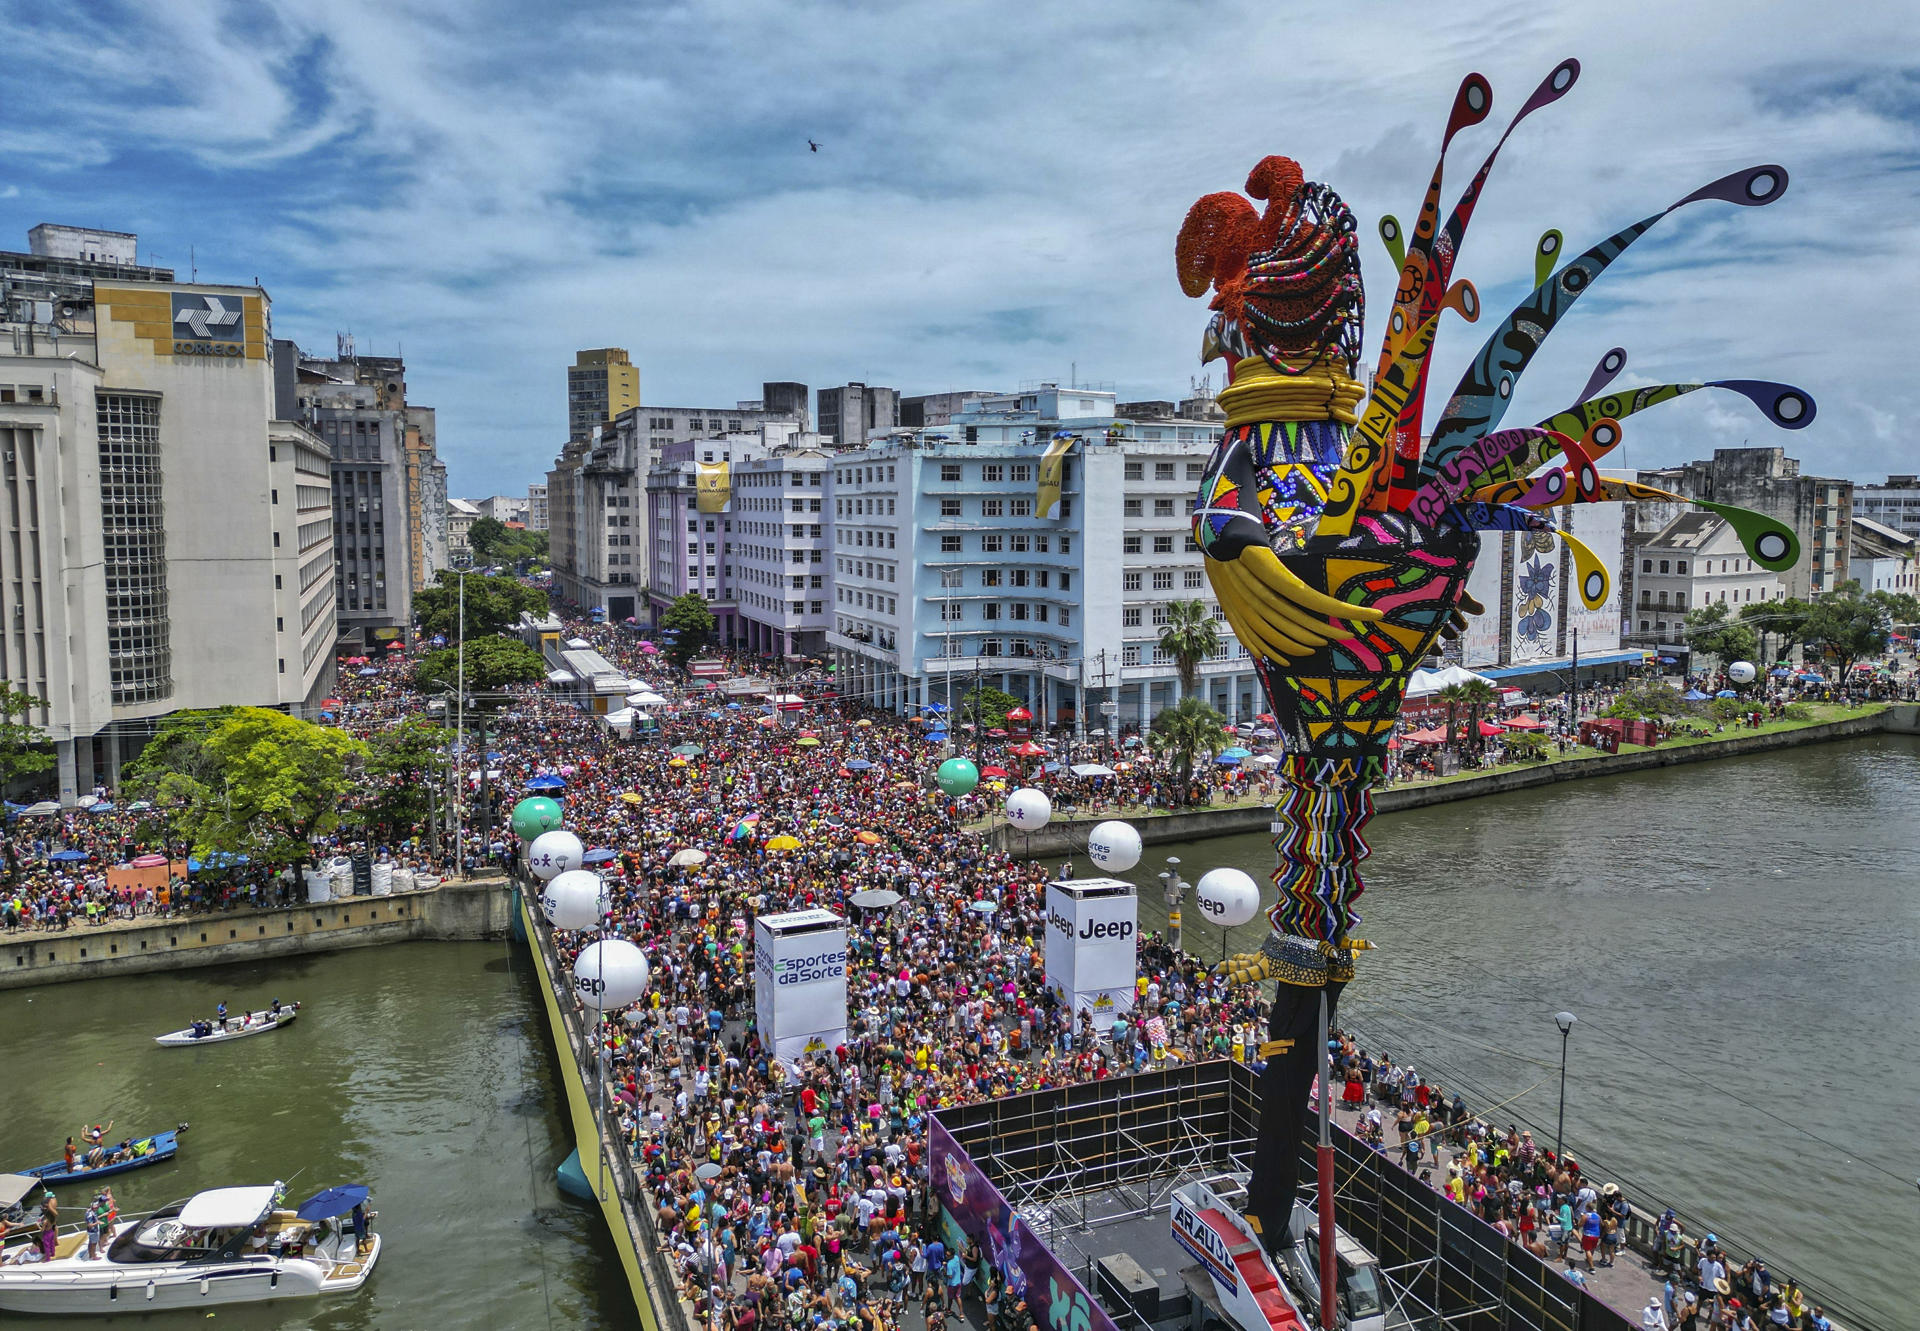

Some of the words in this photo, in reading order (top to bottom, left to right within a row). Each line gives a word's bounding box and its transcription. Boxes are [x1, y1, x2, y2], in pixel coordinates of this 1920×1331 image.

[1197, 893, 1226, 916] eep
[1047, 906, 1074, 940] Jeep
[1079, 918, 1133, 940] Jeep
[774, 951, 846, 972] Esportes
[574, 973, 606, 997] eep
